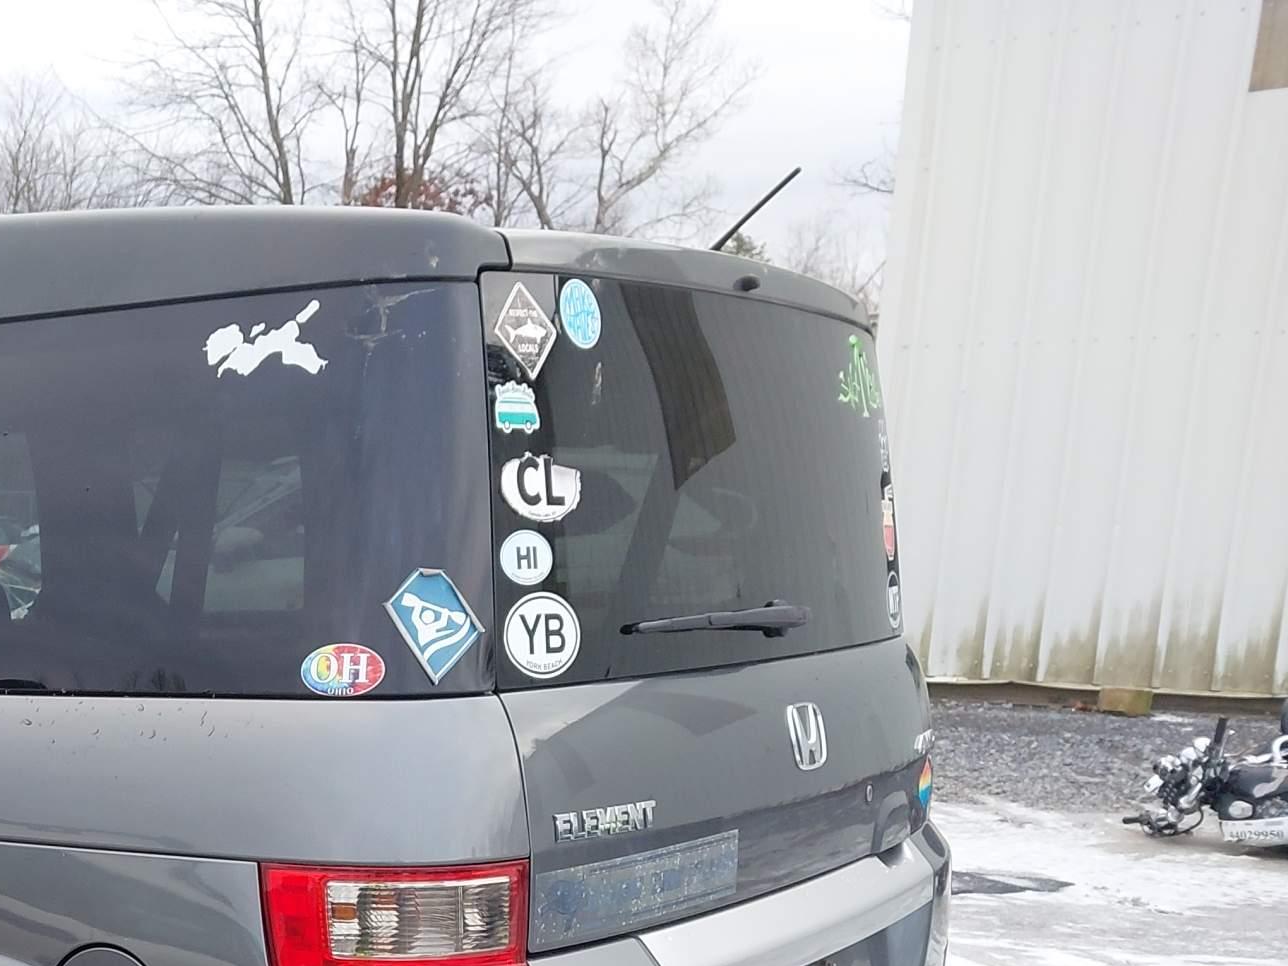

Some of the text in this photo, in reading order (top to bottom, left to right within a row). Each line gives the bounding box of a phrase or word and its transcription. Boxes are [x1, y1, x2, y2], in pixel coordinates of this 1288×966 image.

[518, 343, 539, 353] LOCALS
[516, 456, 566, 506] CL
[516, 546, 538, 569] HI
[518, 613, 566, 655] YB
[310, 652, 371, 684] OH
[526, 658, 563, 671] YORK BEACH
[553, 800, 656, 842] ELEMENT
